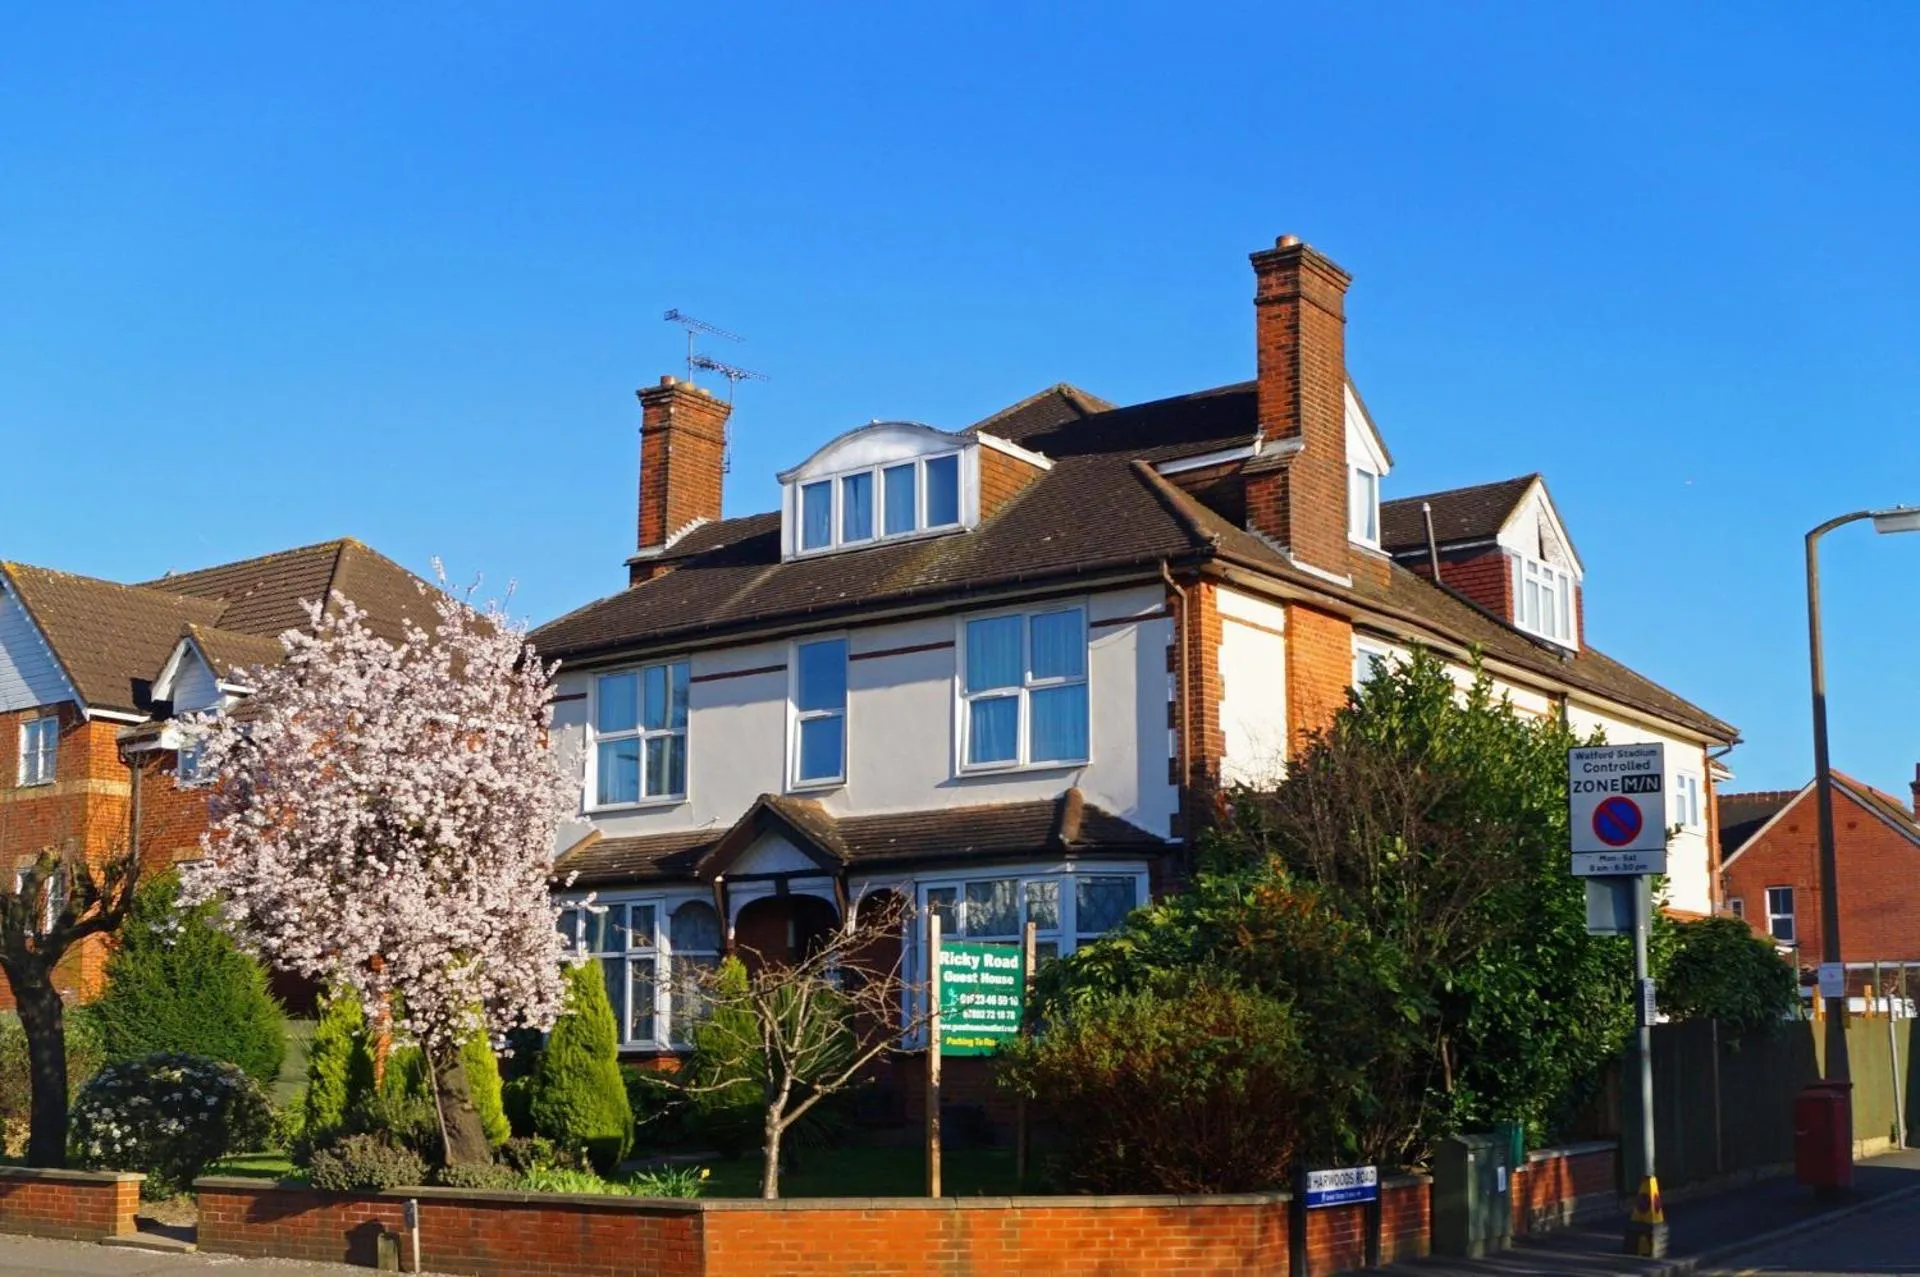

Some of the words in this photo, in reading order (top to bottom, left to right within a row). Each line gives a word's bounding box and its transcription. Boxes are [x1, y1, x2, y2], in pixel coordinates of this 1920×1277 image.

[1575, 749, 1614, 760] Watford
[1617, 748, 1657, 758] Stadium
[1583, 760, 1650, 773] Controlled
[1573, 779, 1620, 793] ZONE
[1624, 776, 1658, 791] M/N
[939, 951, 980, 969] Ricky
[984, 953, 1019, 969] Road
[943, 971, 978, 983] Guest
[980, 972, 1014, 985] House
[1356, 1169, 1375, 1184] ROAD
